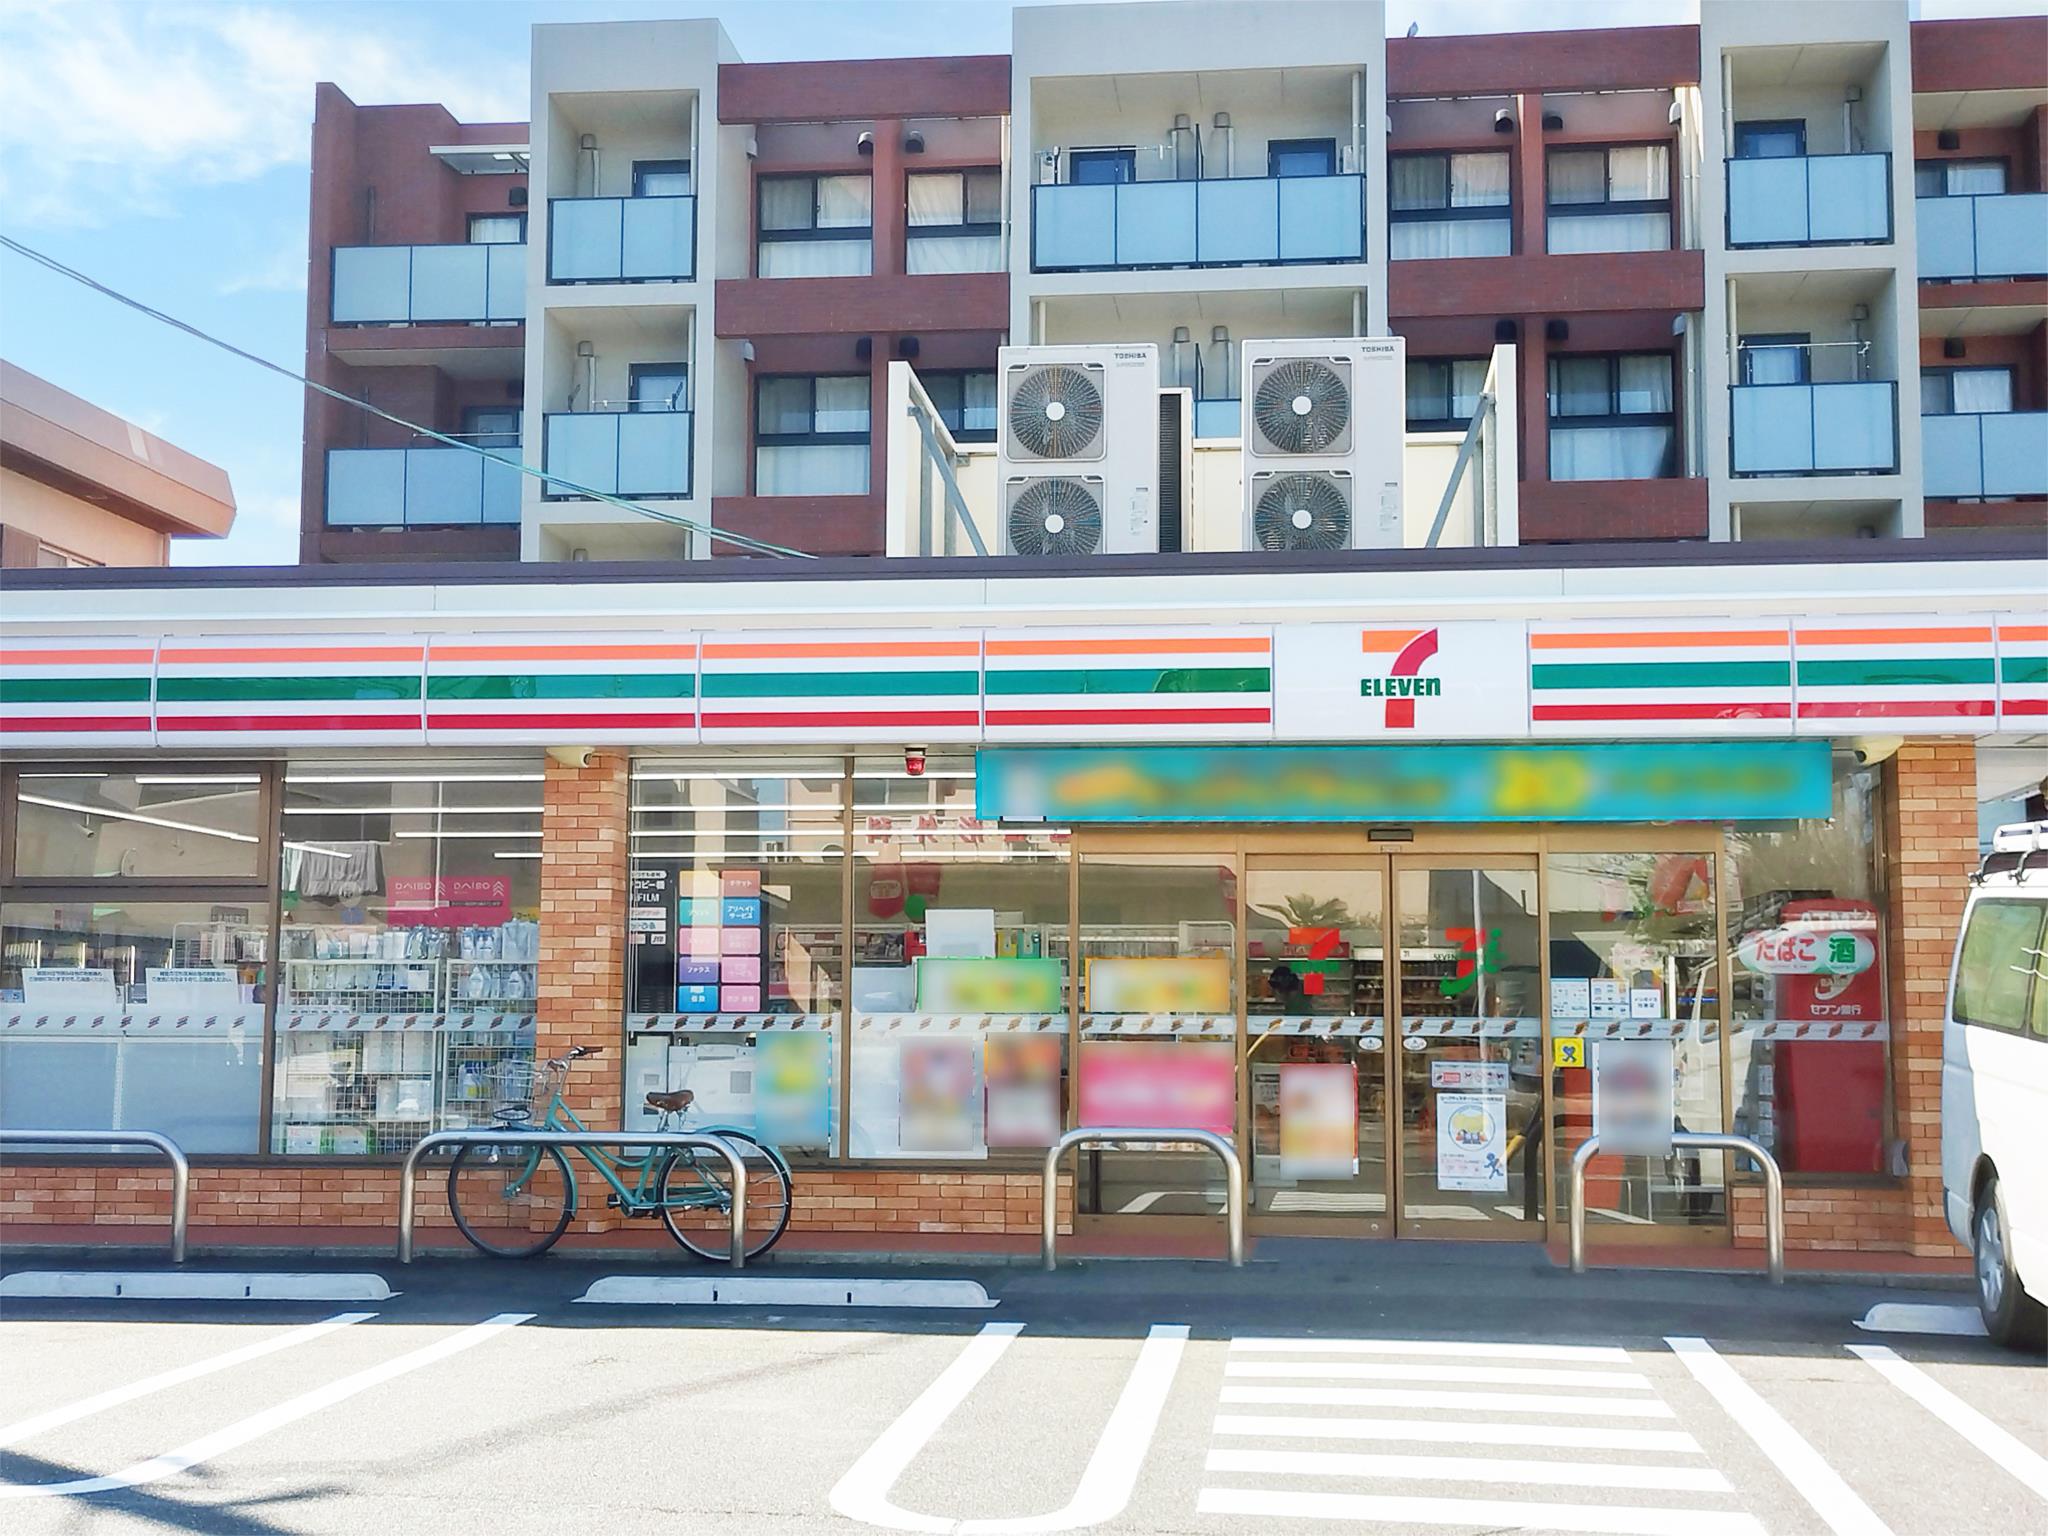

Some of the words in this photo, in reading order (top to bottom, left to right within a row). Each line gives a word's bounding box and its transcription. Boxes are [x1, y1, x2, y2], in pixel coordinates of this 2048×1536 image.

[1755, 936, 1817, 962] たばこ
[1829, 937, 1856, 963] 酒
